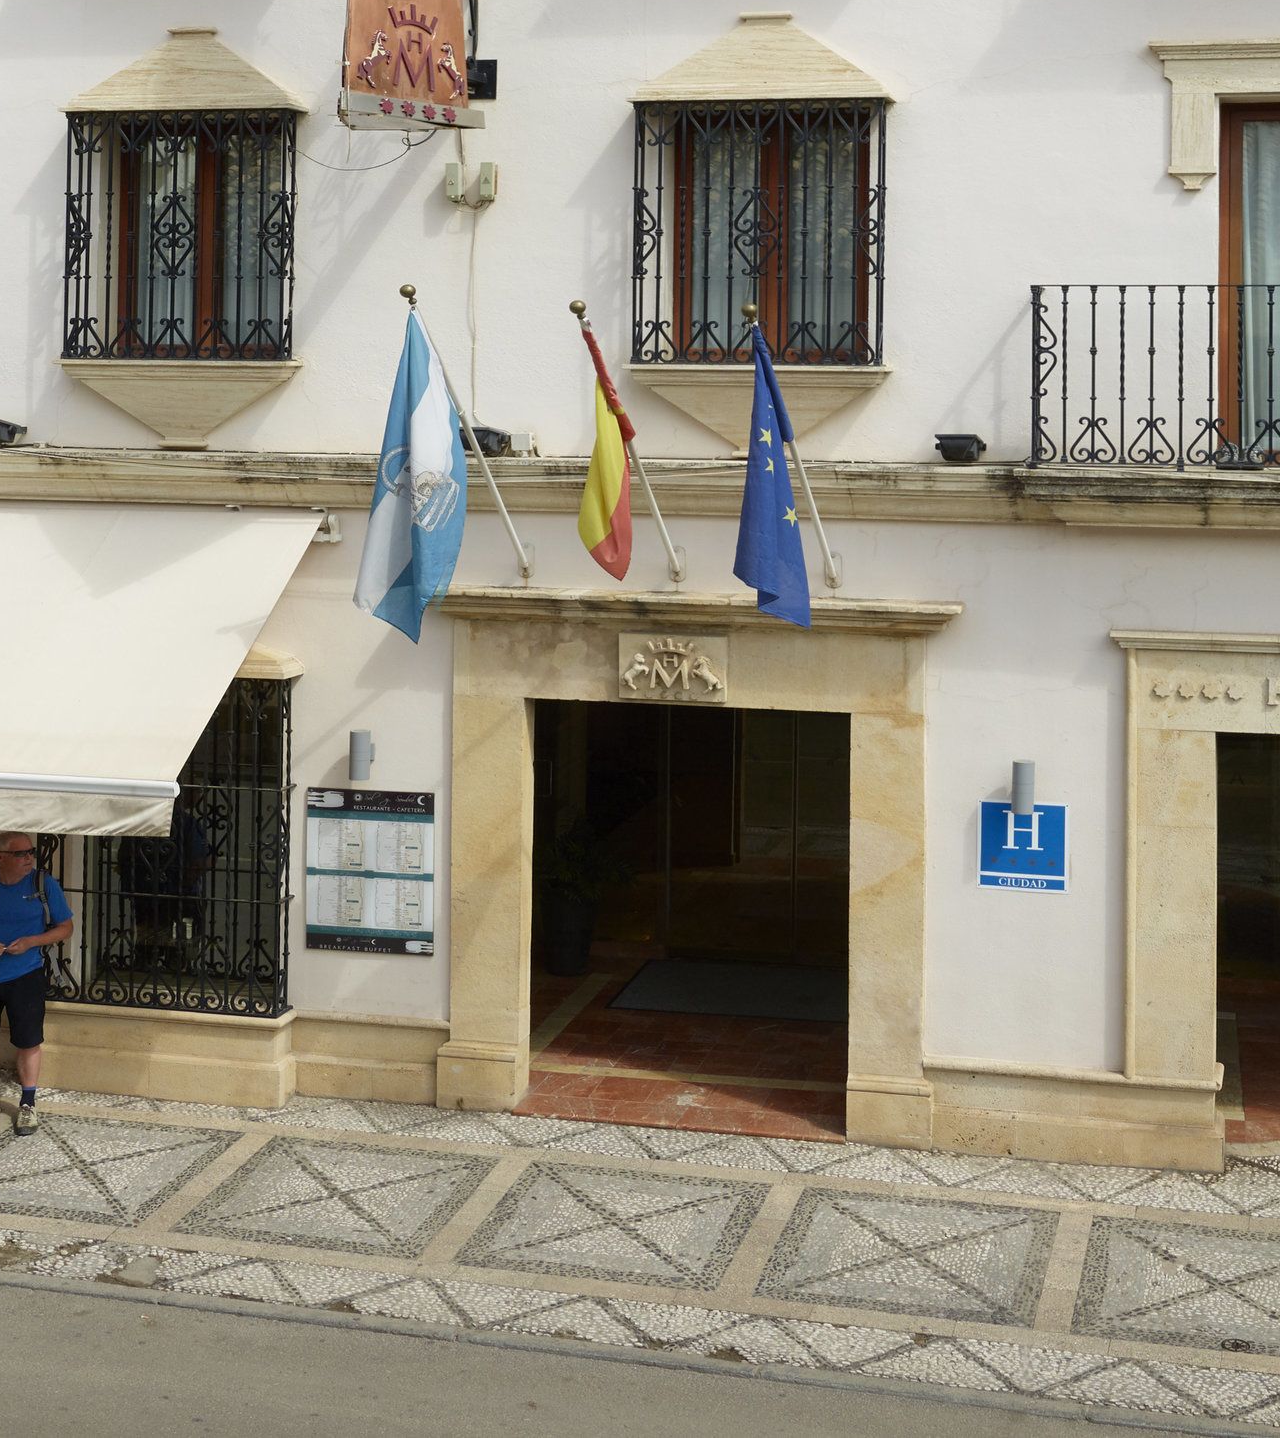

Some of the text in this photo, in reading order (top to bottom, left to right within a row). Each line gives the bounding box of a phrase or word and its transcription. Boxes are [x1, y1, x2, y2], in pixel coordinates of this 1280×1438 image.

[1002, 809, 1044, 851] H
[998, 877, 1047, 890] CIUDAD
[319, 944, 361, 952] BREAKFAST
